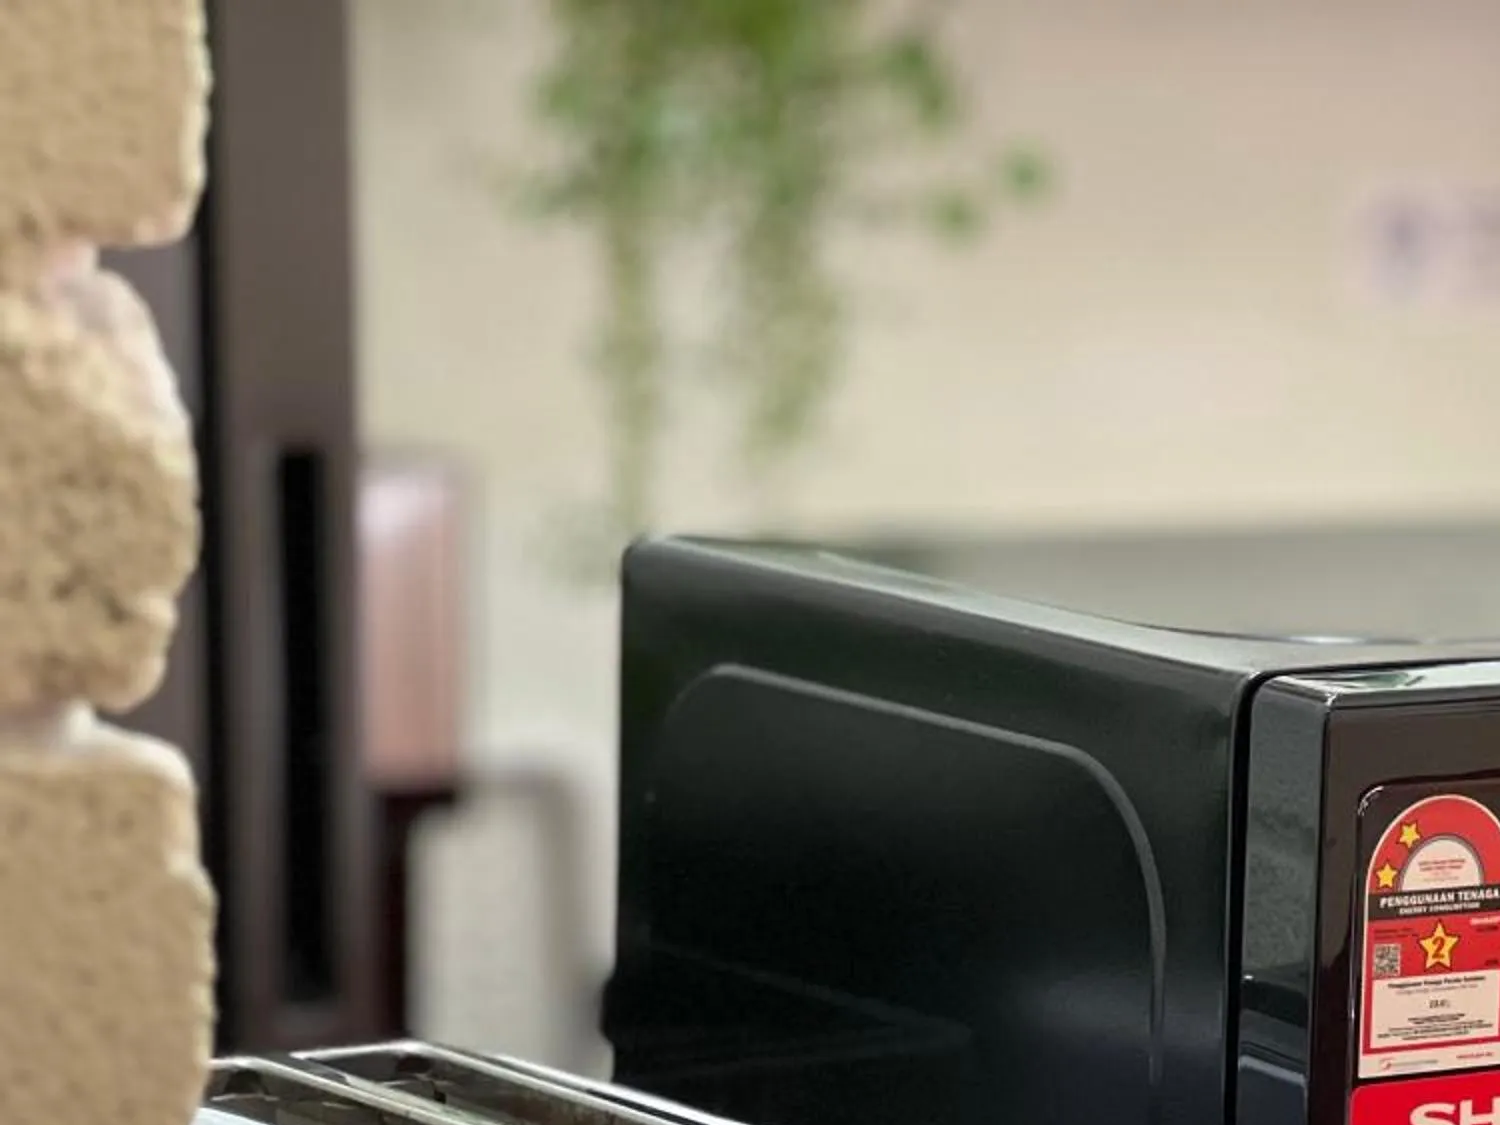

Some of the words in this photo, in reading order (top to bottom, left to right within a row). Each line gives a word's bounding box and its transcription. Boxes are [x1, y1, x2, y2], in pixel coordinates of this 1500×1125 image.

[1379, 891, 1455, 909] PENGGUNAAN
[1457, 887, 1500, 901] TENAGA
[1431, 936, 1446, 959] 2
